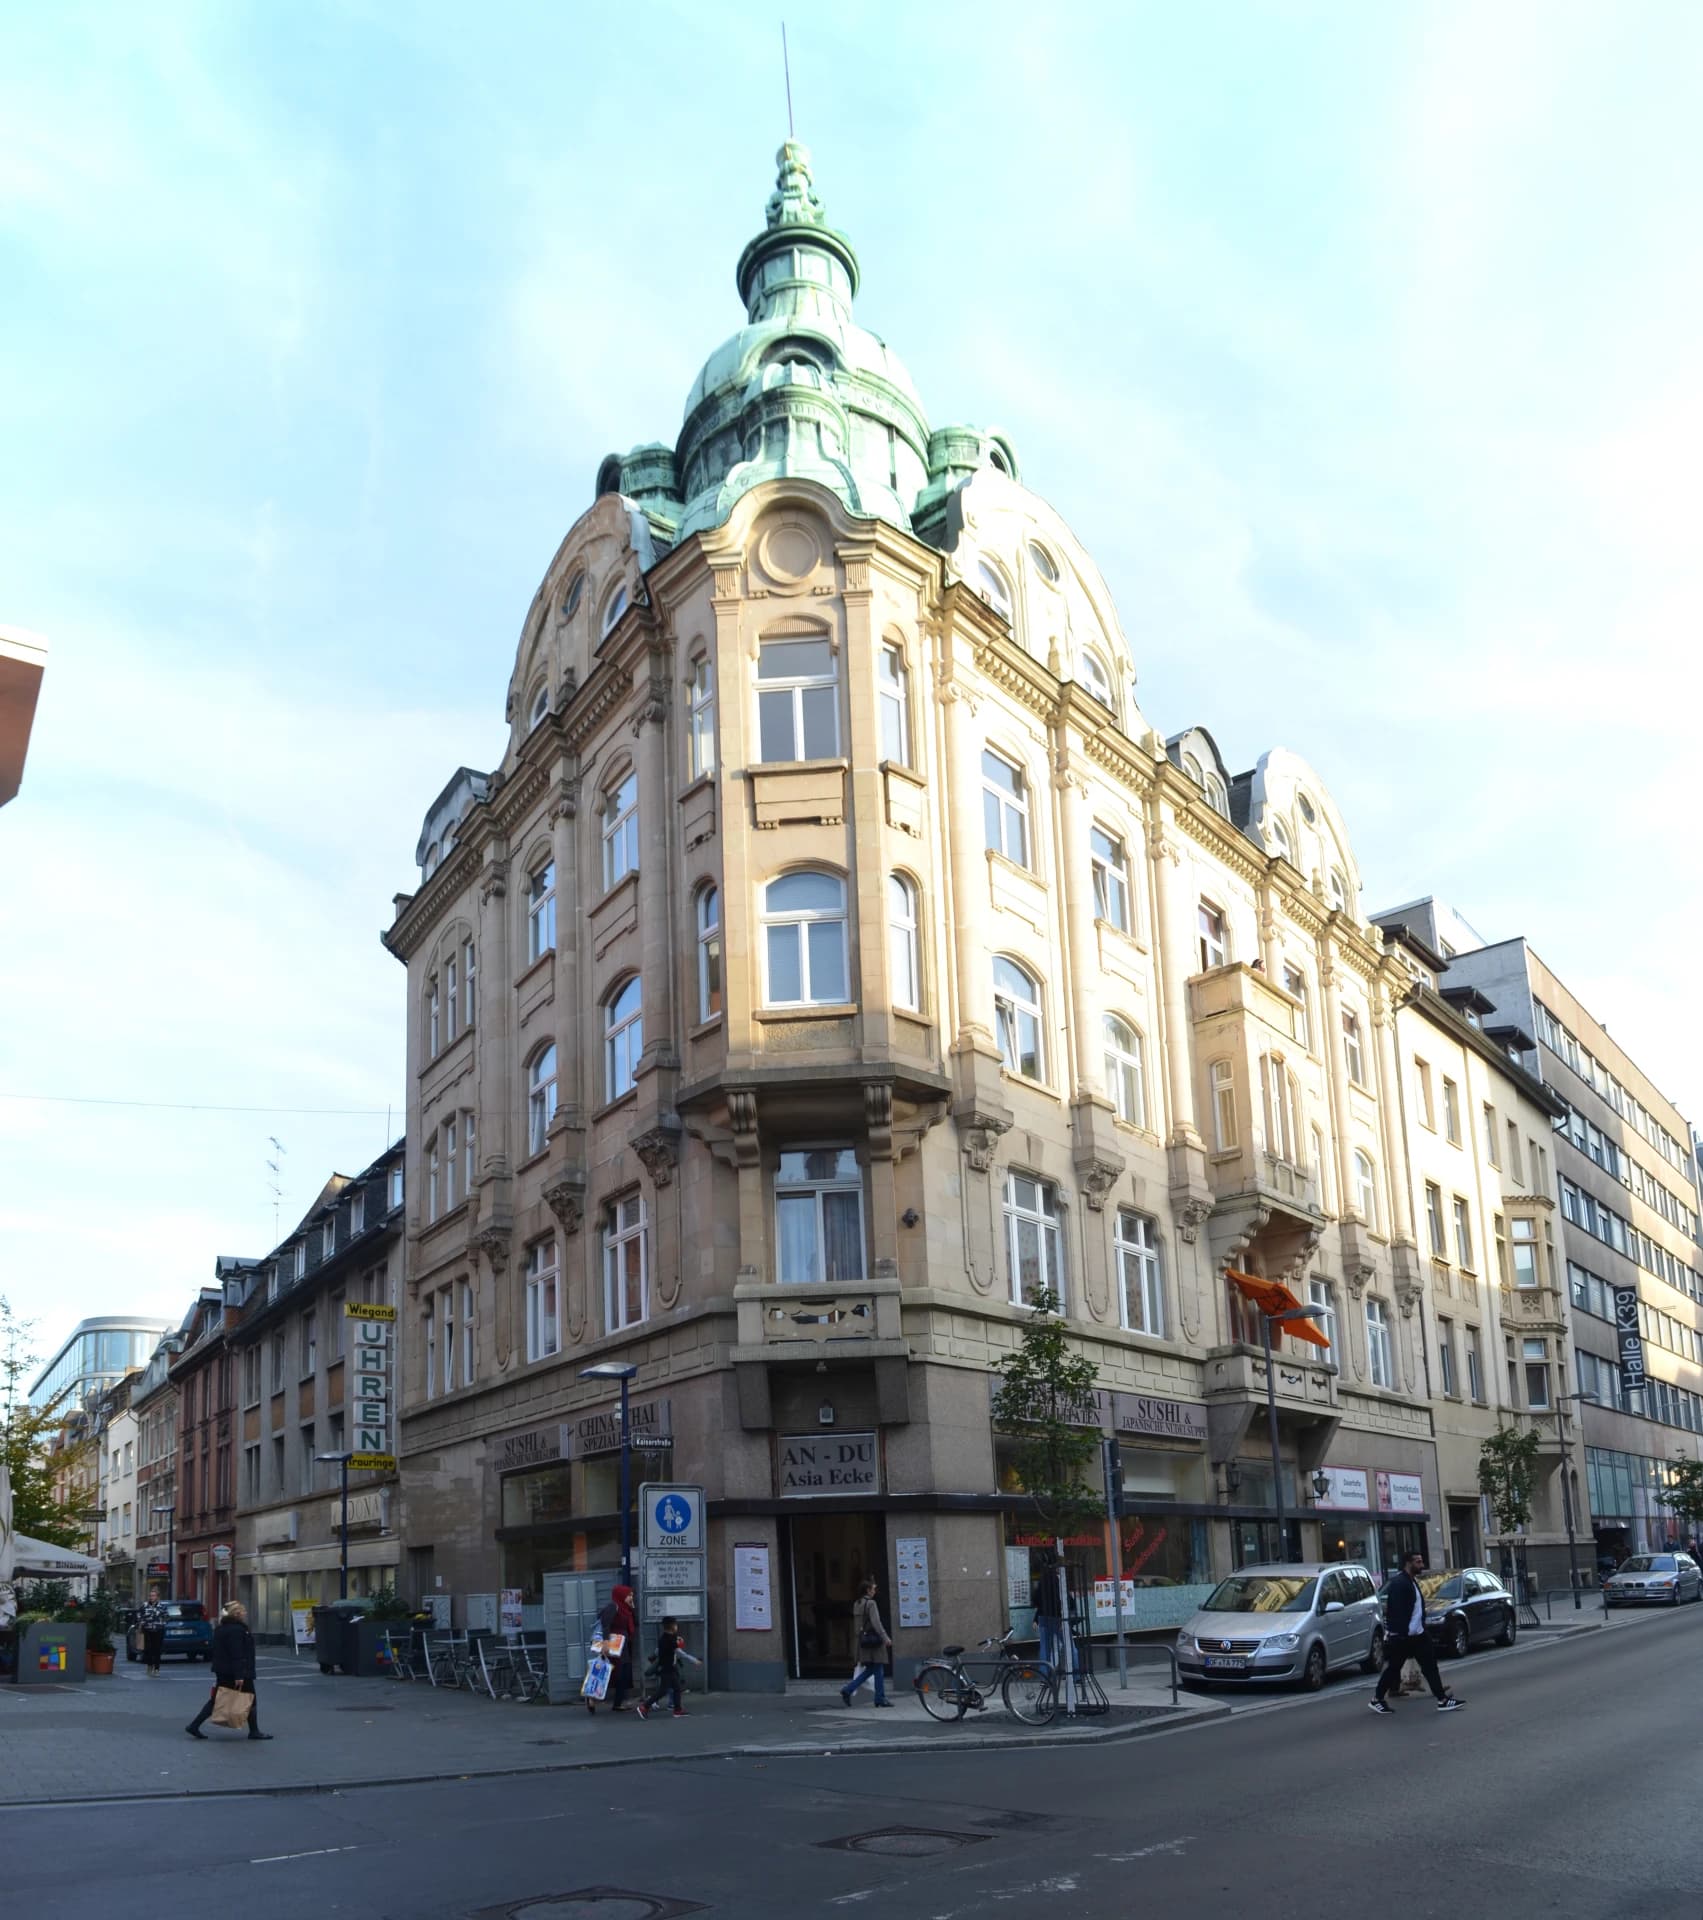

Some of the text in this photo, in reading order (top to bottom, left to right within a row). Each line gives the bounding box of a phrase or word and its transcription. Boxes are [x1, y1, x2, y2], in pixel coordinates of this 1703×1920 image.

[349, 1303, 395, 1318] Wiegand
[1616, 1291, 1644, 1388] Halle K39
[361, 1323, 382, 1451] UHREN
[1137, 1398, 1192, 1425] SUSHI &
[578, 1413, 615, 1439] CHINA
[505, 1432, 538, 1457] SUSHI
[782, 1446, 817, 1466] AN
[837, 1442, 873, 1464] DU
[783, 1467, 873, 1488] Asia Ecke
[660, 1535, 688, 1546] ZONE
